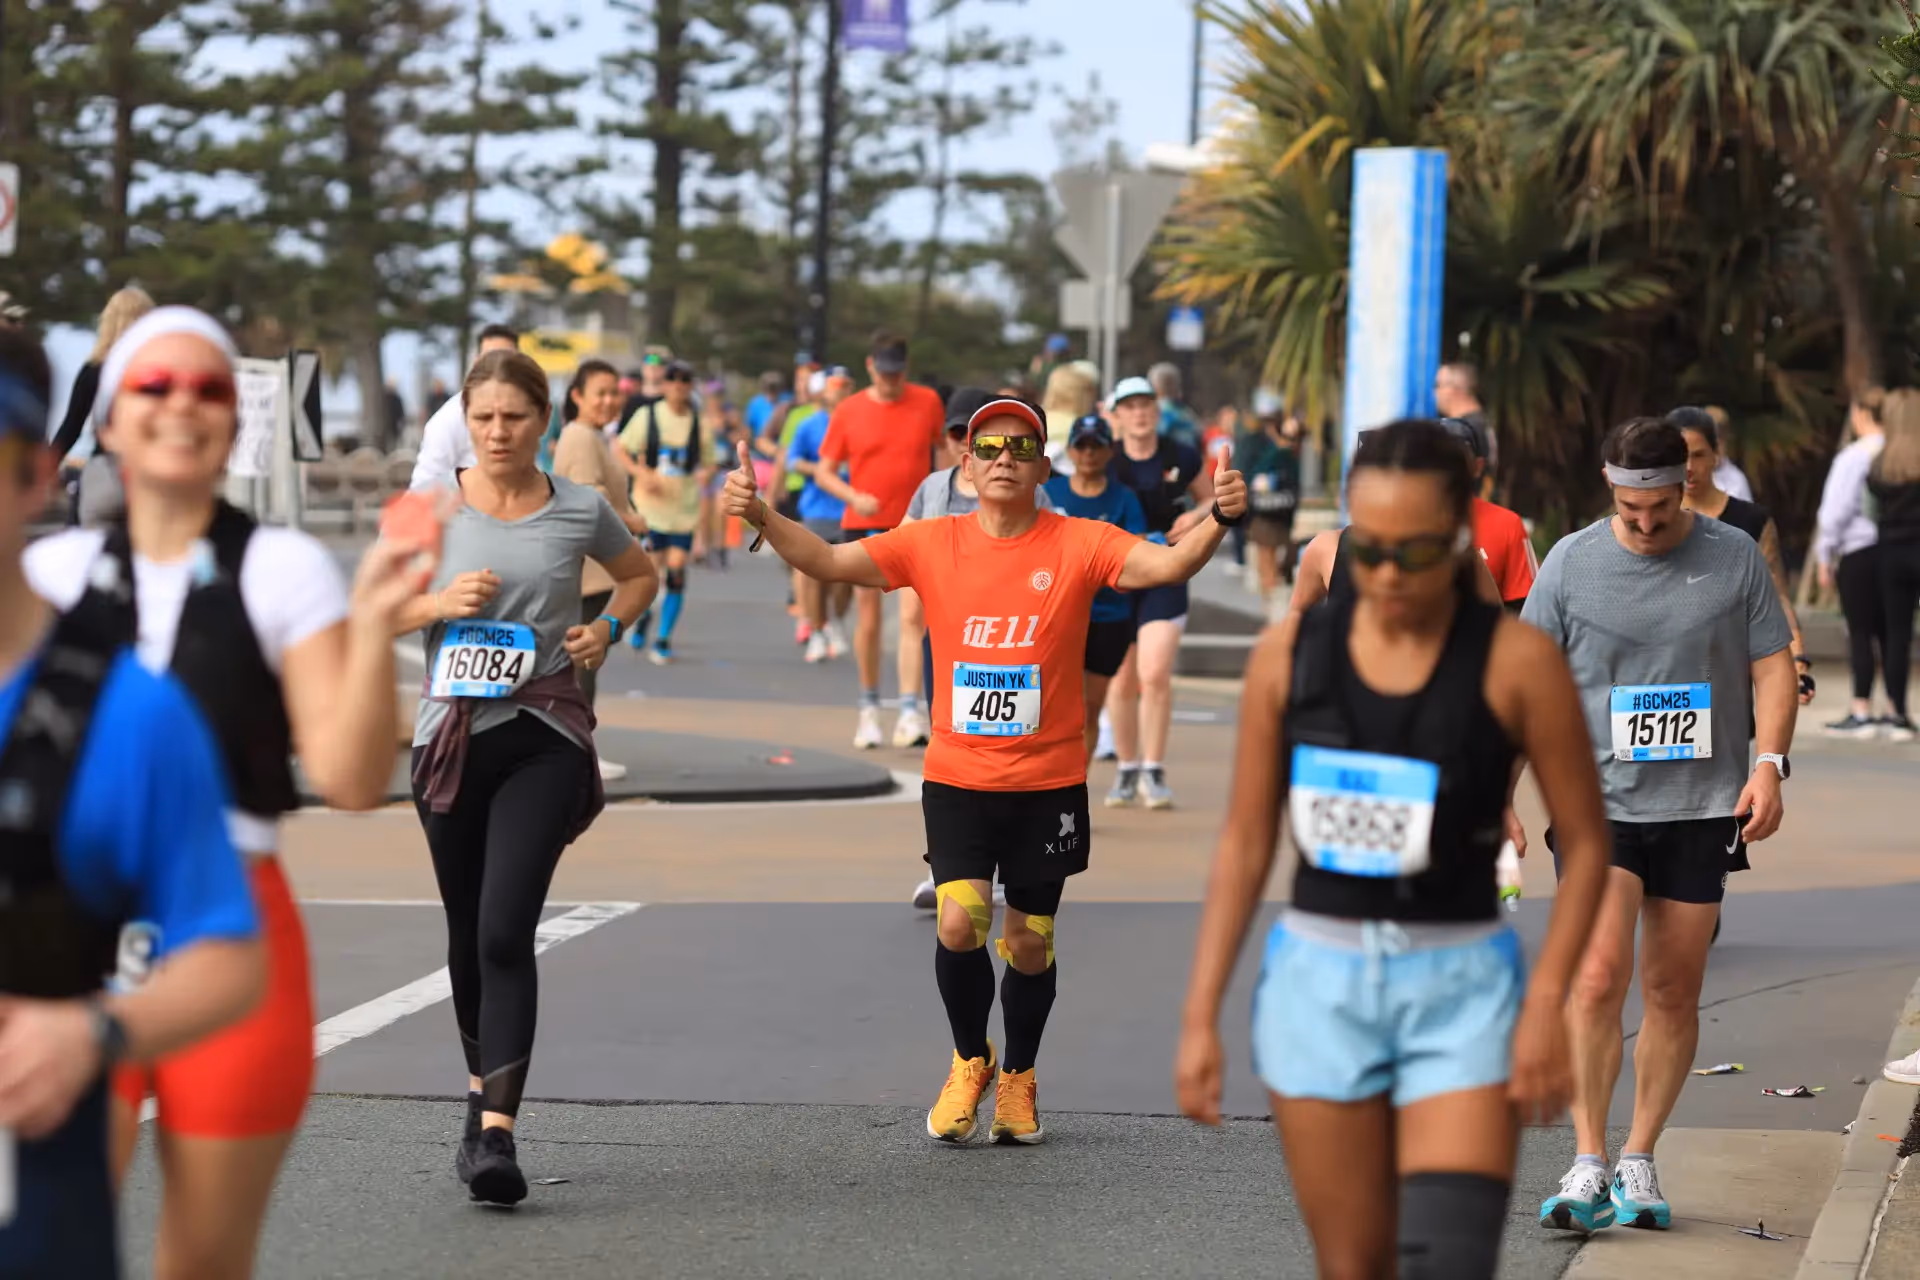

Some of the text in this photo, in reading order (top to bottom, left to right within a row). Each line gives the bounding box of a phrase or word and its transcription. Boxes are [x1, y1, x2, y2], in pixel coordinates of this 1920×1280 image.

[446, 647, 525, 684] 16084
[963, 671, 1026, 689] JUSTIN YK
[969, 690, 1018, 722] 405
[1633, 691, 1691, 711] #GCM25
[1627, 710, 1698, 747] 15112
[1059, 837, 1079, 852] LIF
